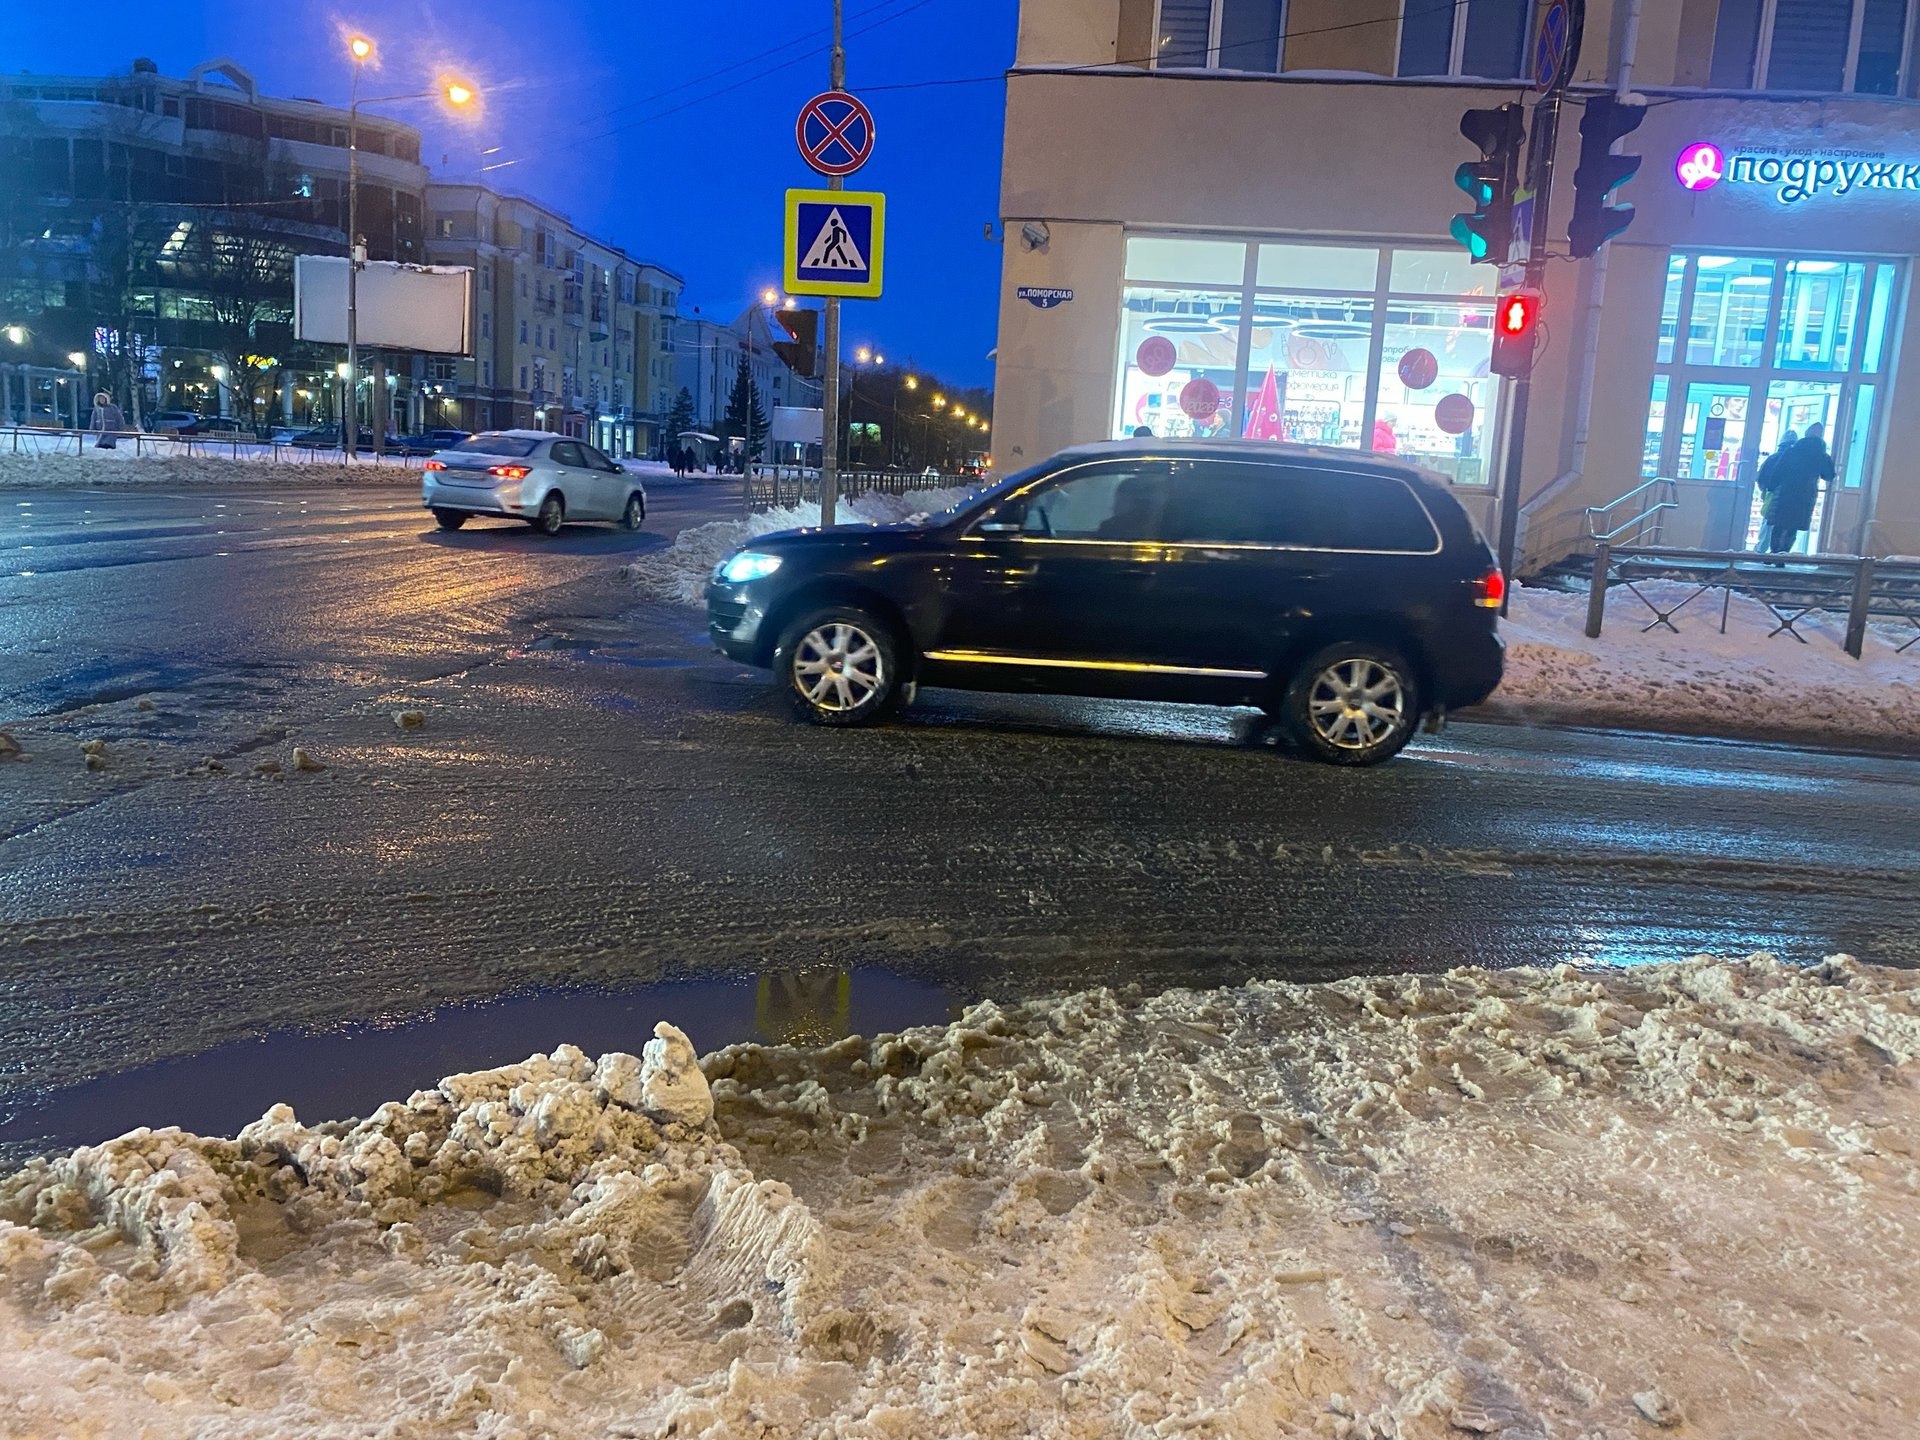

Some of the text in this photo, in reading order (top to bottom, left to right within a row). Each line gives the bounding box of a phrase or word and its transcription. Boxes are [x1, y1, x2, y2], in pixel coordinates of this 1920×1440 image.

[1733, 144, 1886, 160] красота уход настроение
[1042, 298, 1048, 307] 5
